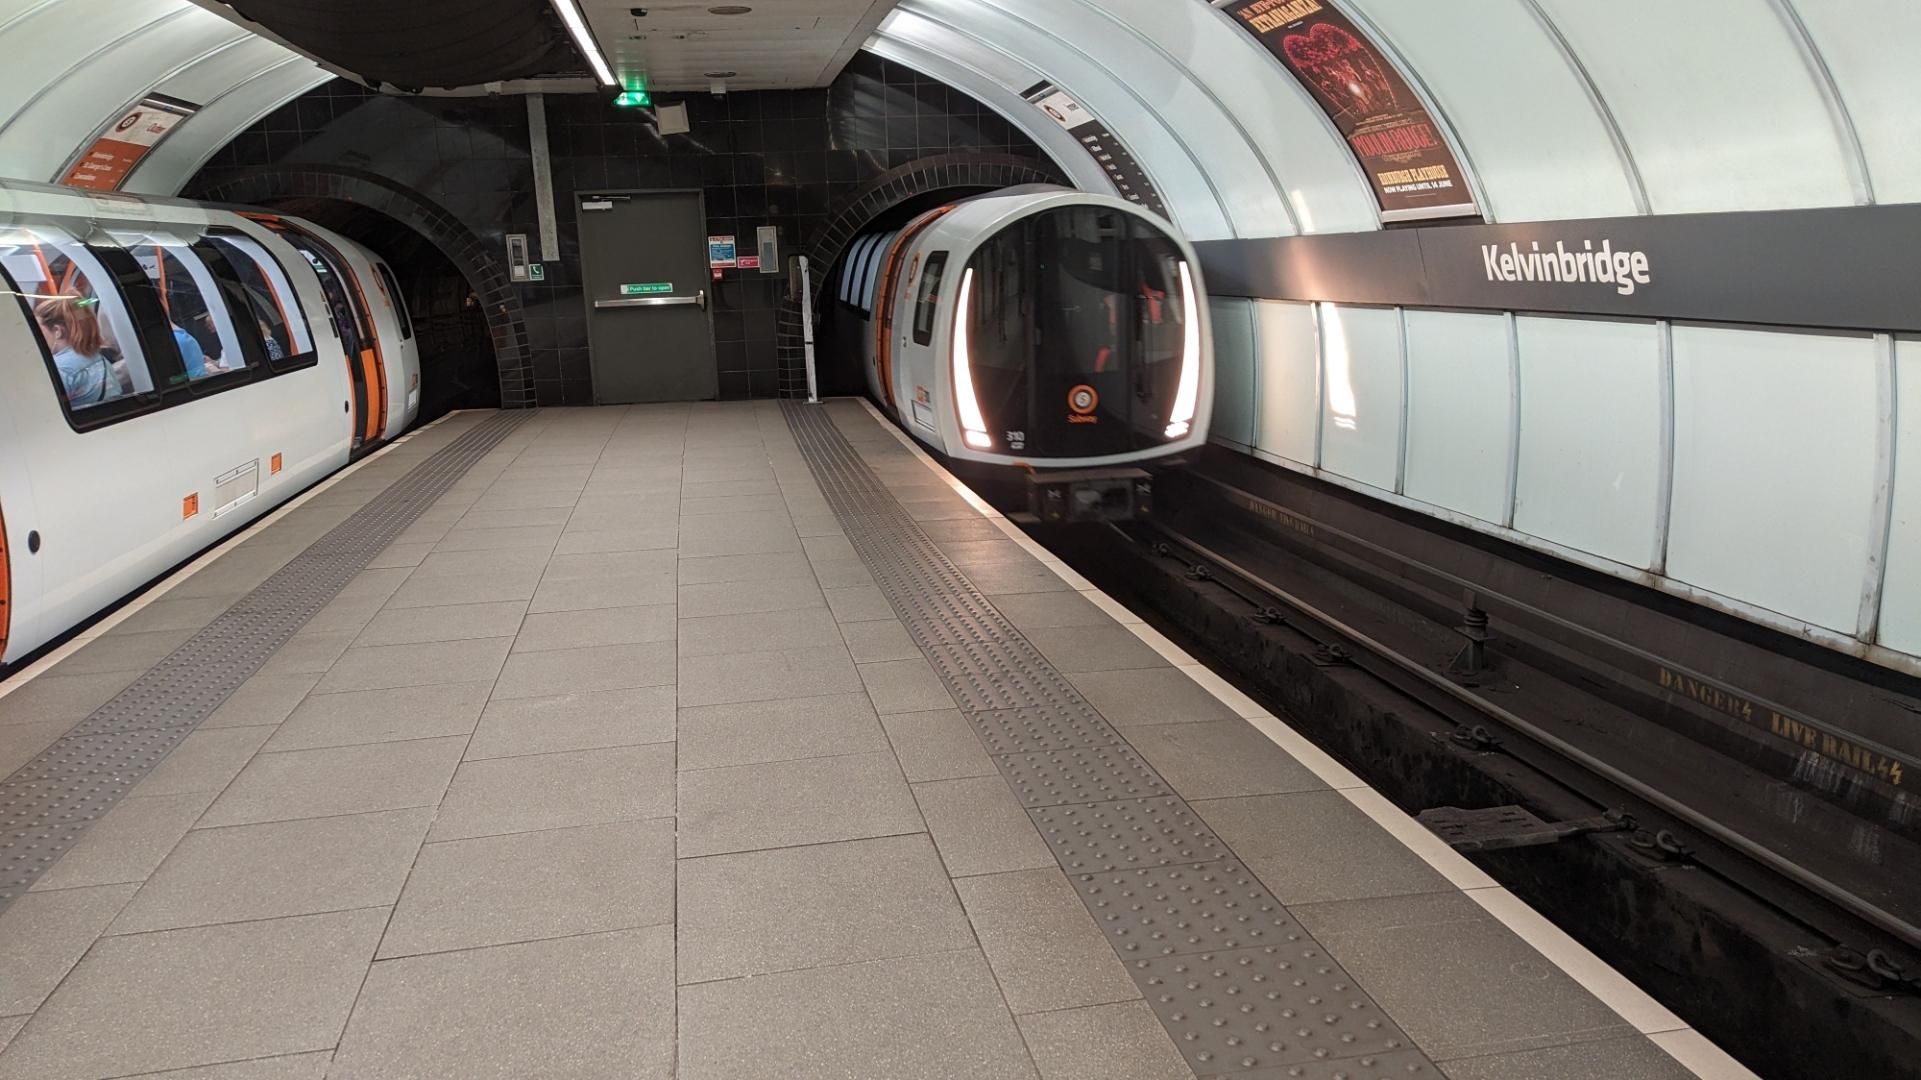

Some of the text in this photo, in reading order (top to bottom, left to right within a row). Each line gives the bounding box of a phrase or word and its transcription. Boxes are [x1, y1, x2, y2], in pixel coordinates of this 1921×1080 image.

[1352, 131, 1398, 158] MOULIN
[1383, 185, 1397, 194] NOW
[1396, 183, 1417, 192] PLAYING
[1415, 181, 1432, 190] UNTIL
[1438, 179, 1453, 188] JUNE
[1409, 164, 1449, 182] PLAYHOUSE
[1481, 239, 1651, 295] Kelvinbridge
[1659, 667, 1876, 775] DANGER LIVE RAIL
